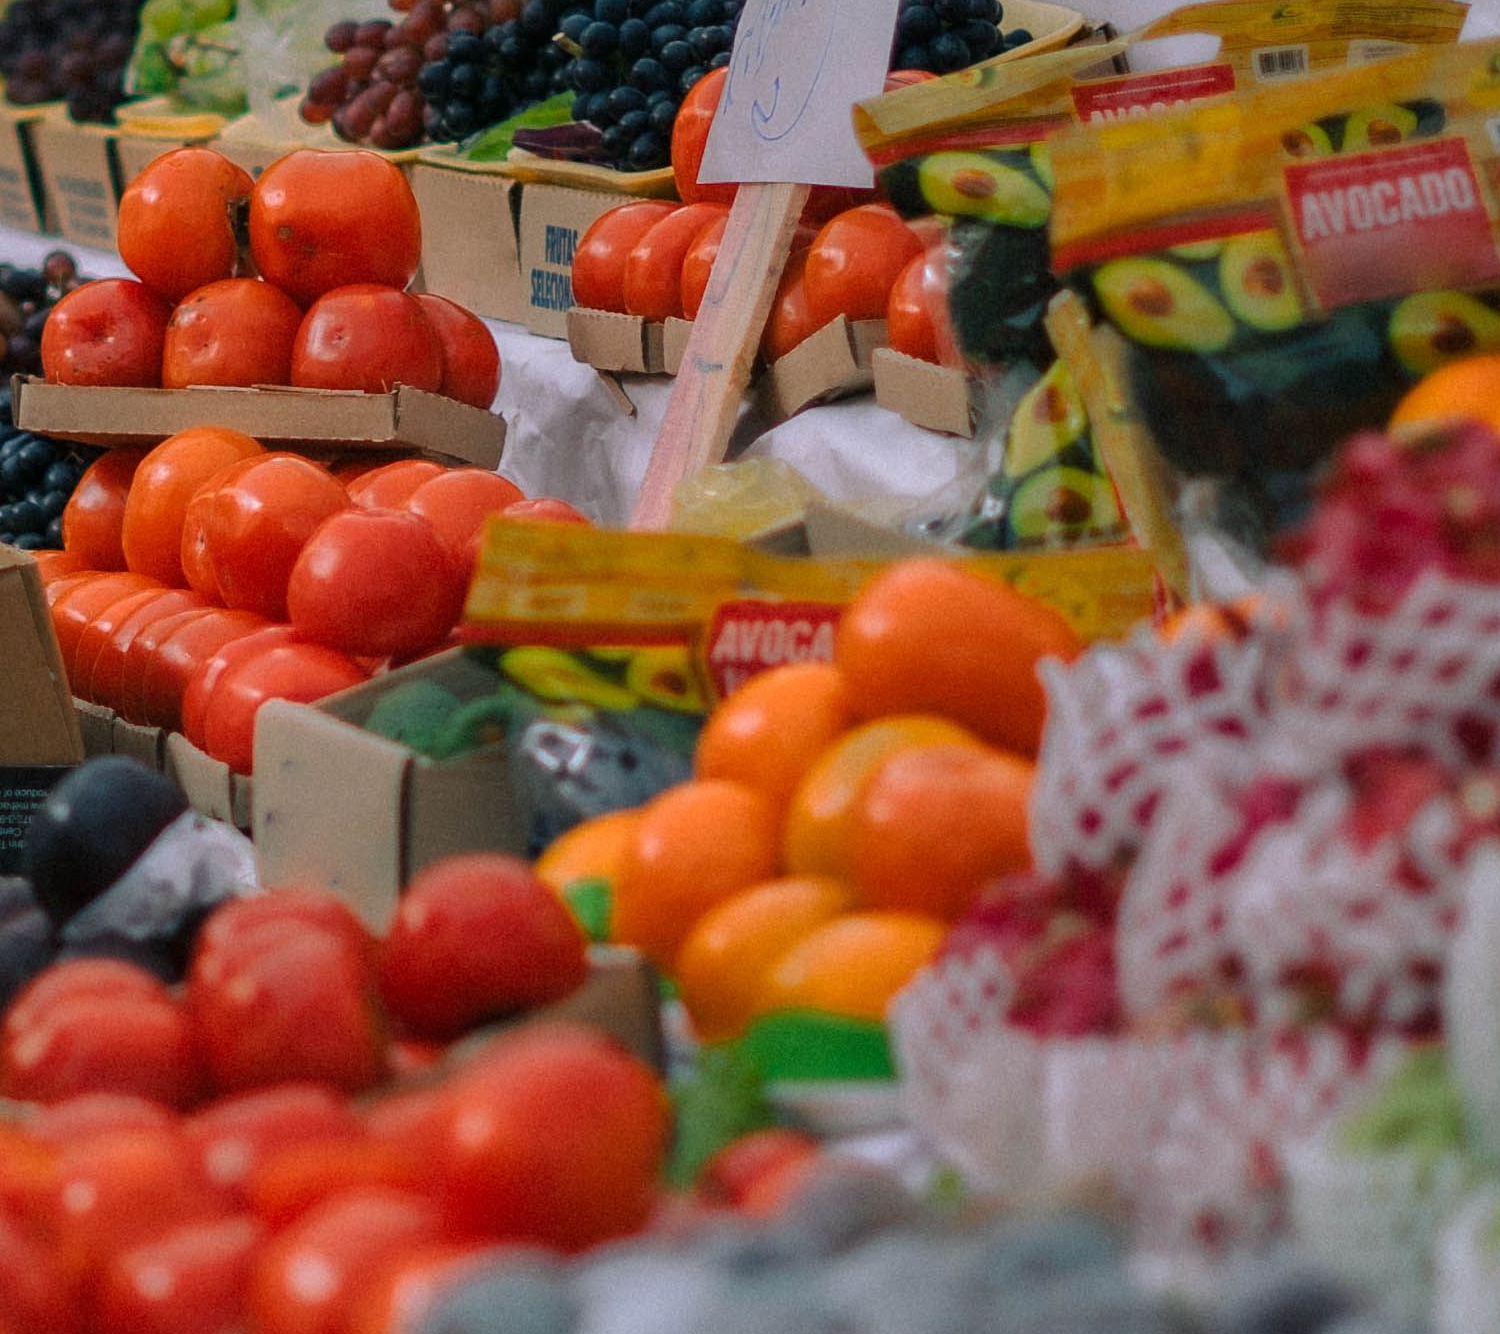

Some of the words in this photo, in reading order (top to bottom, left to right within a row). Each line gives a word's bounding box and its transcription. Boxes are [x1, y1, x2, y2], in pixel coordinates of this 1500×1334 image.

[1302, 167, 1476, 240] AVOCADO
[545, 224, 579, 266] FRUTAS
[711, 618, 835, 664] AVOCA
[13, 789, 50, 798] roduce
